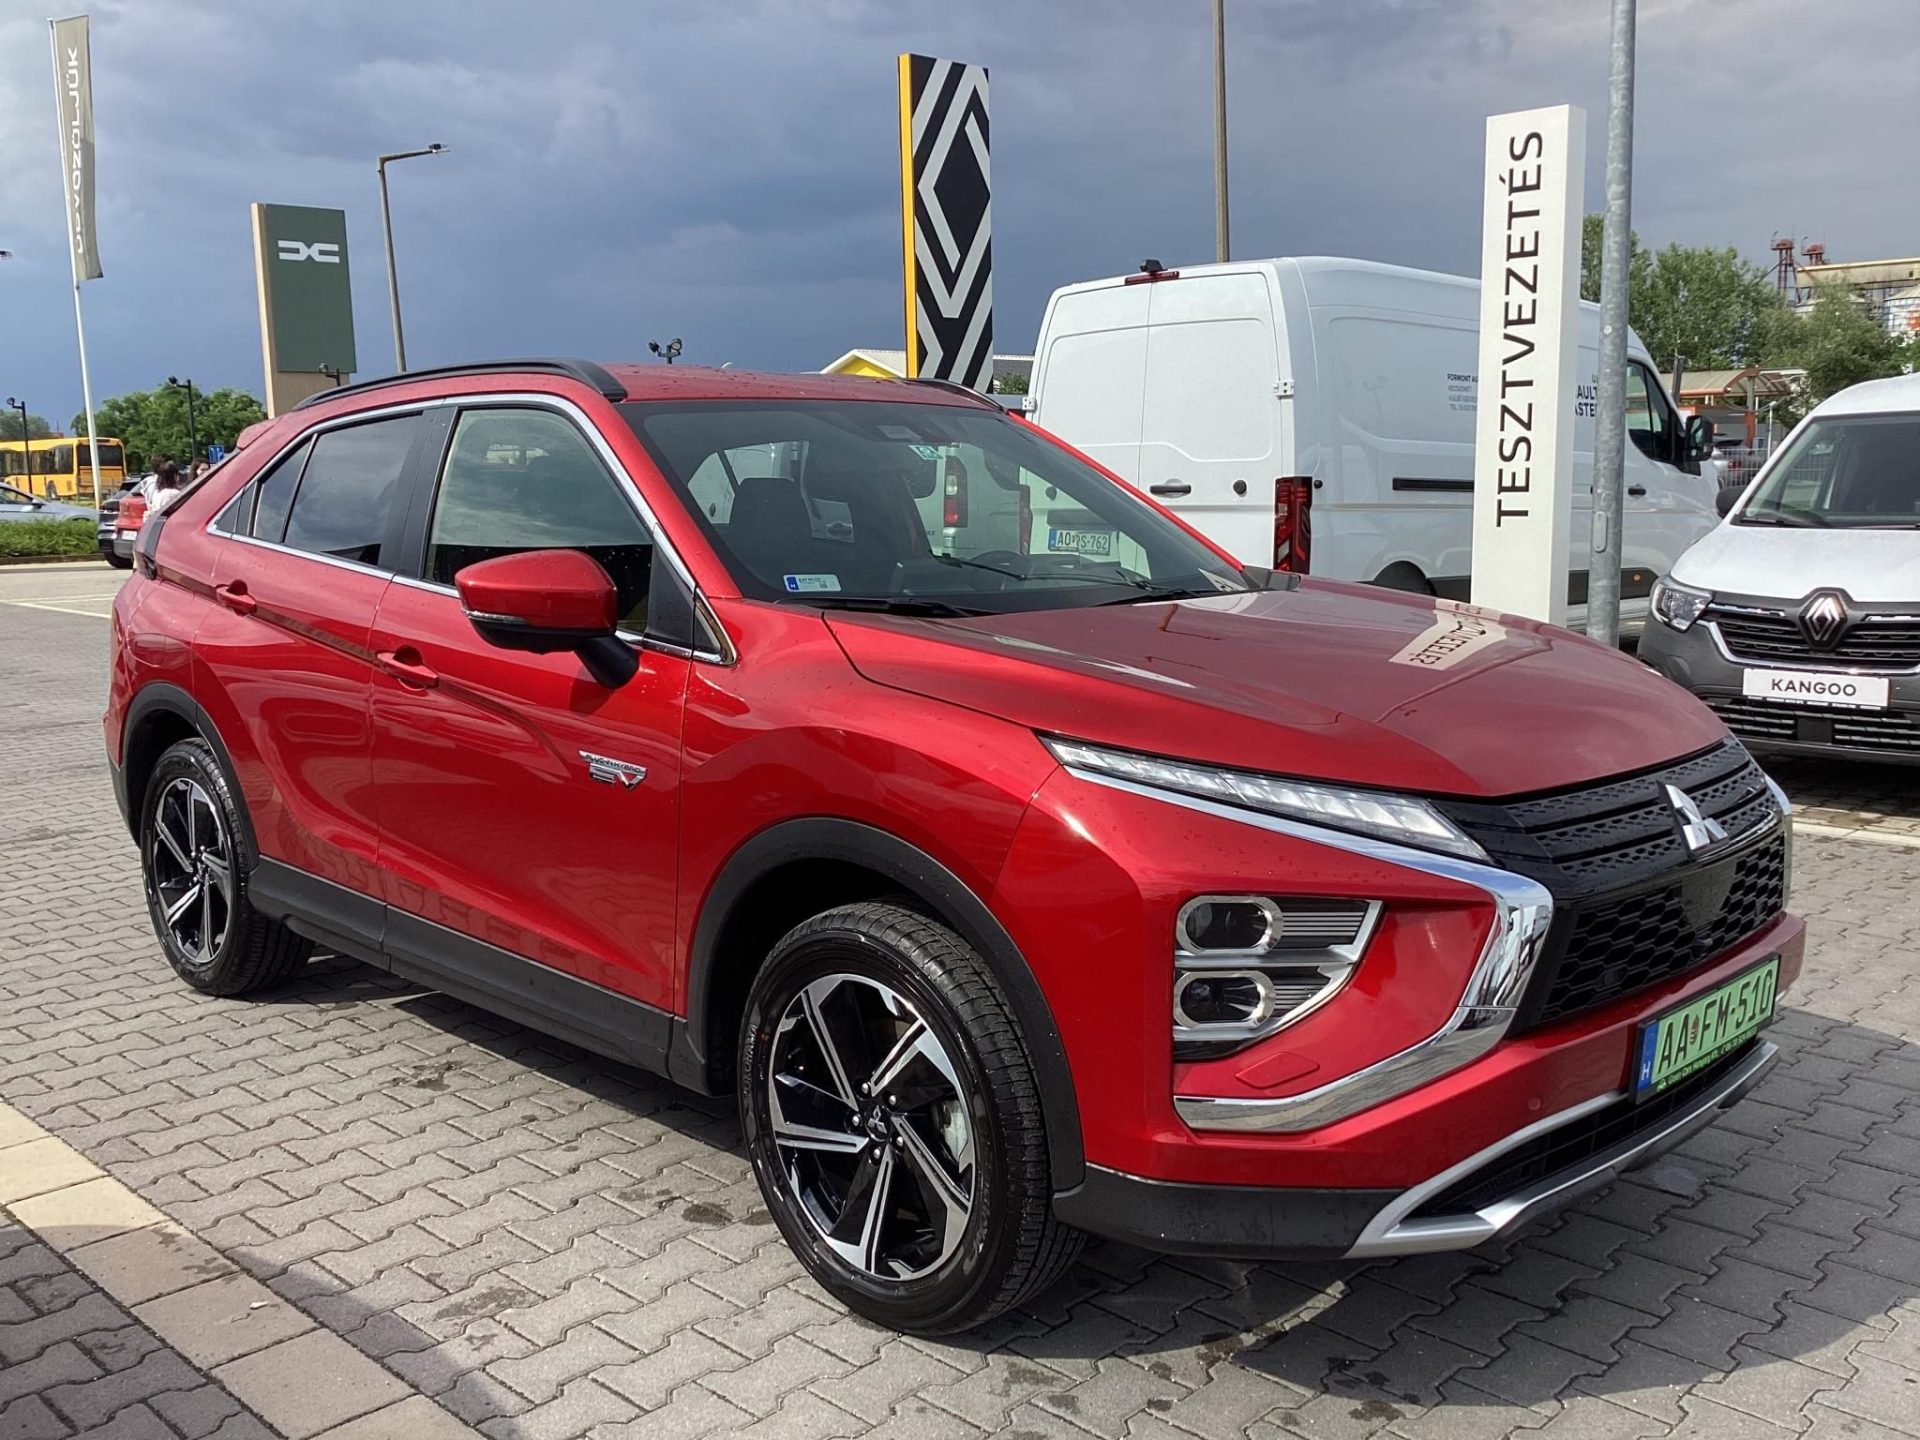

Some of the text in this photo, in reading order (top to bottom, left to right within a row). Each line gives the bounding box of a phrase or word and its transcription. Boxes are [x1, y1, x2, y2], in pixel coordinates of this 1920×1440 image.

[1496, 131, 1544, 527] TESZTVEZETÉS
[1575, 403, 1597, 417] STE
[1771, 678, 1857, 697] KANGOO
[1657, 1012, 1690, 1074] AA
